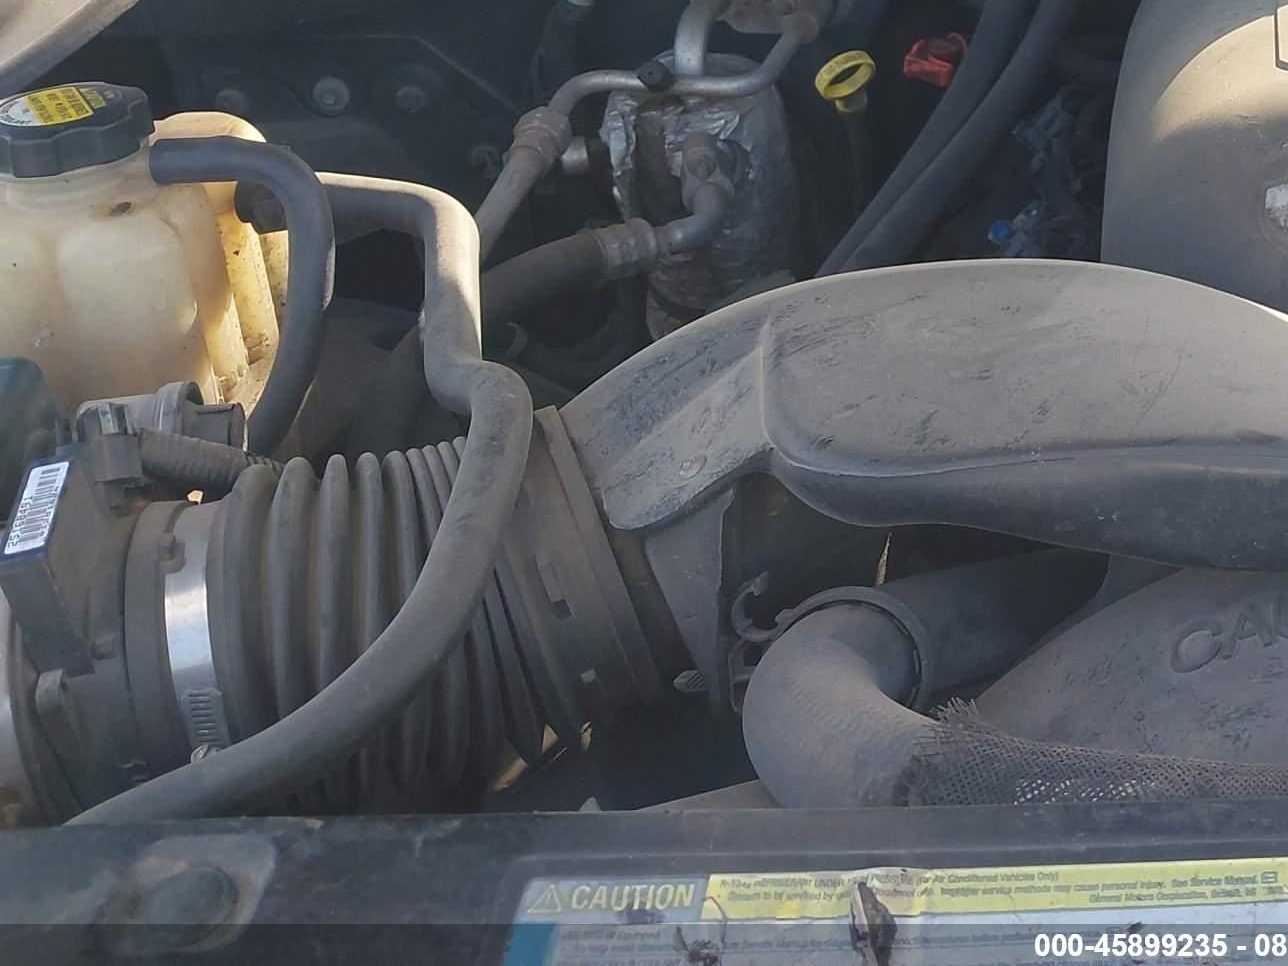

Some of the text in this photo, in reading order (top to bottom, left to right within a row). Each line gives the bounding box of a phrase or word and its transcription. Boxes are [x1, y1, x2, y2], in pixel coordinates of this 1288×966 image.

[947, 873, 998, 883] Conditioned
[1001, 872, 1035, 882] Vehicles
[1037, 870, 1059, 882] Only)
[571, 883, 695, 911] CAUTION
